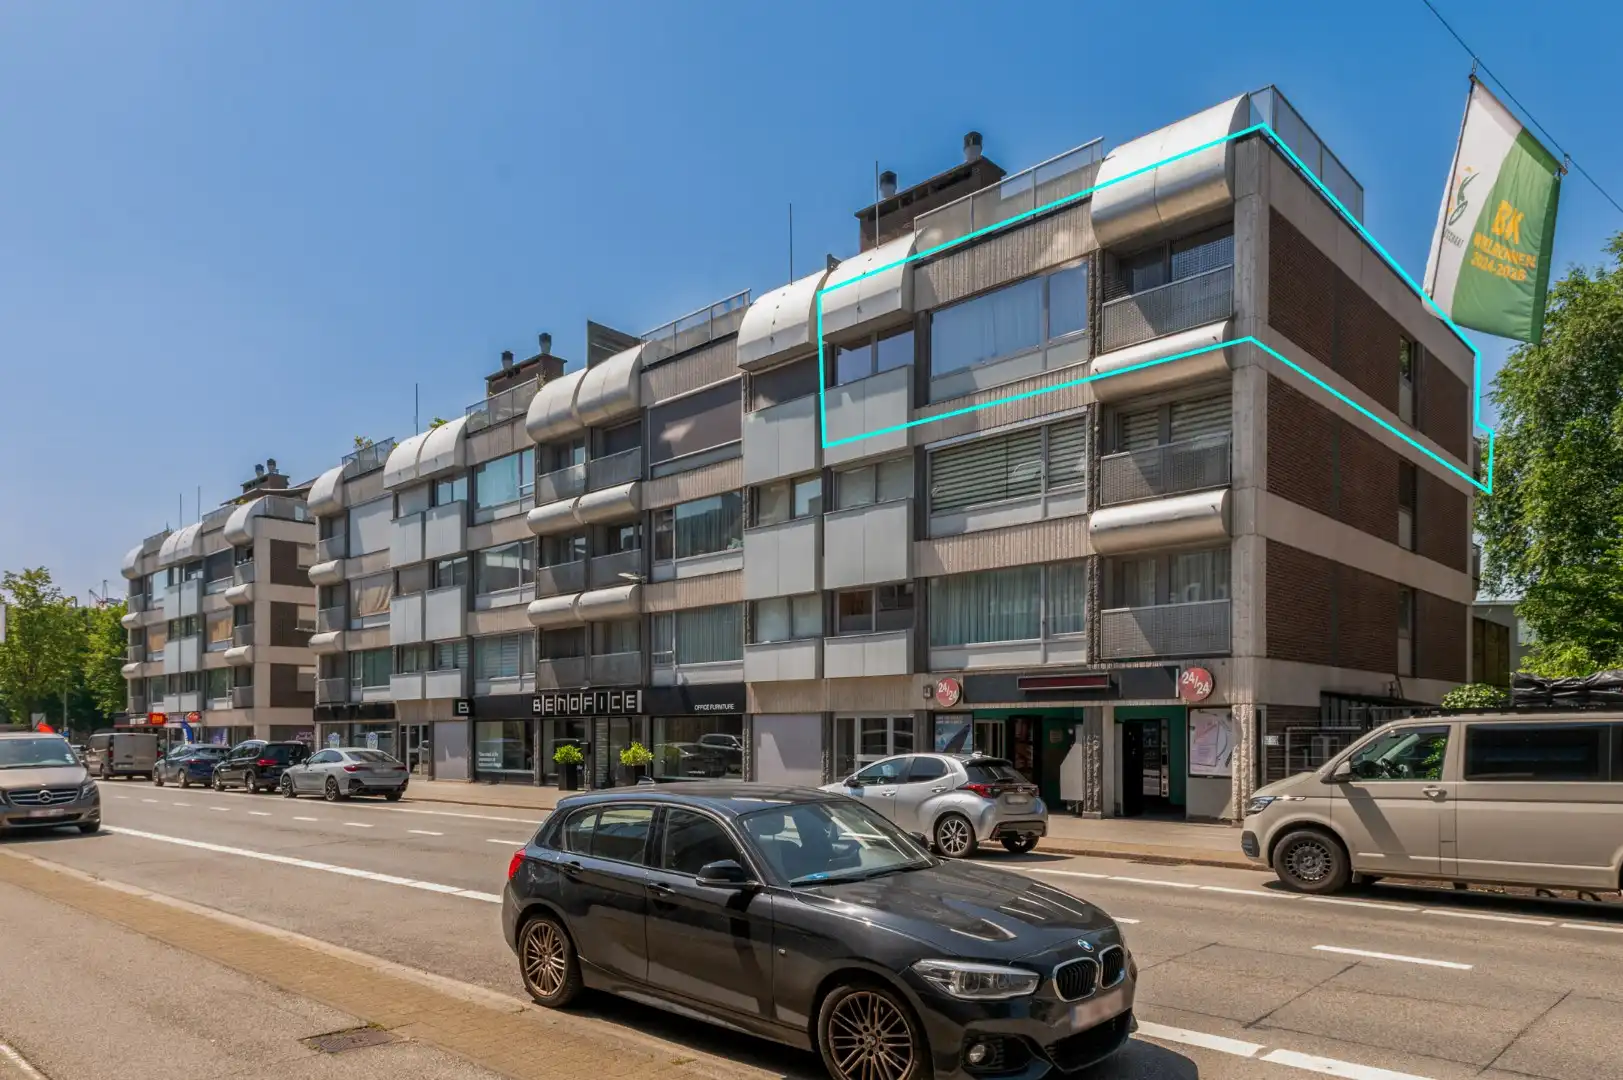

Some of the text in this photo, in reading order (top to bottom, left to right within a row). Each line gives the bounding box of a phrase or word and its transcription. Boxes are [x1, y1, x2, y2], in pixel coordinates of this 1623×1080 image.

[1491, 199, 1525, 245] BK
[938, 681, 959, 701] 24/24
[1181, 671, 1210, 695] 24/24
[458, 702, 469, 713] B
[532, 694, 636, 713] BENOFICE
